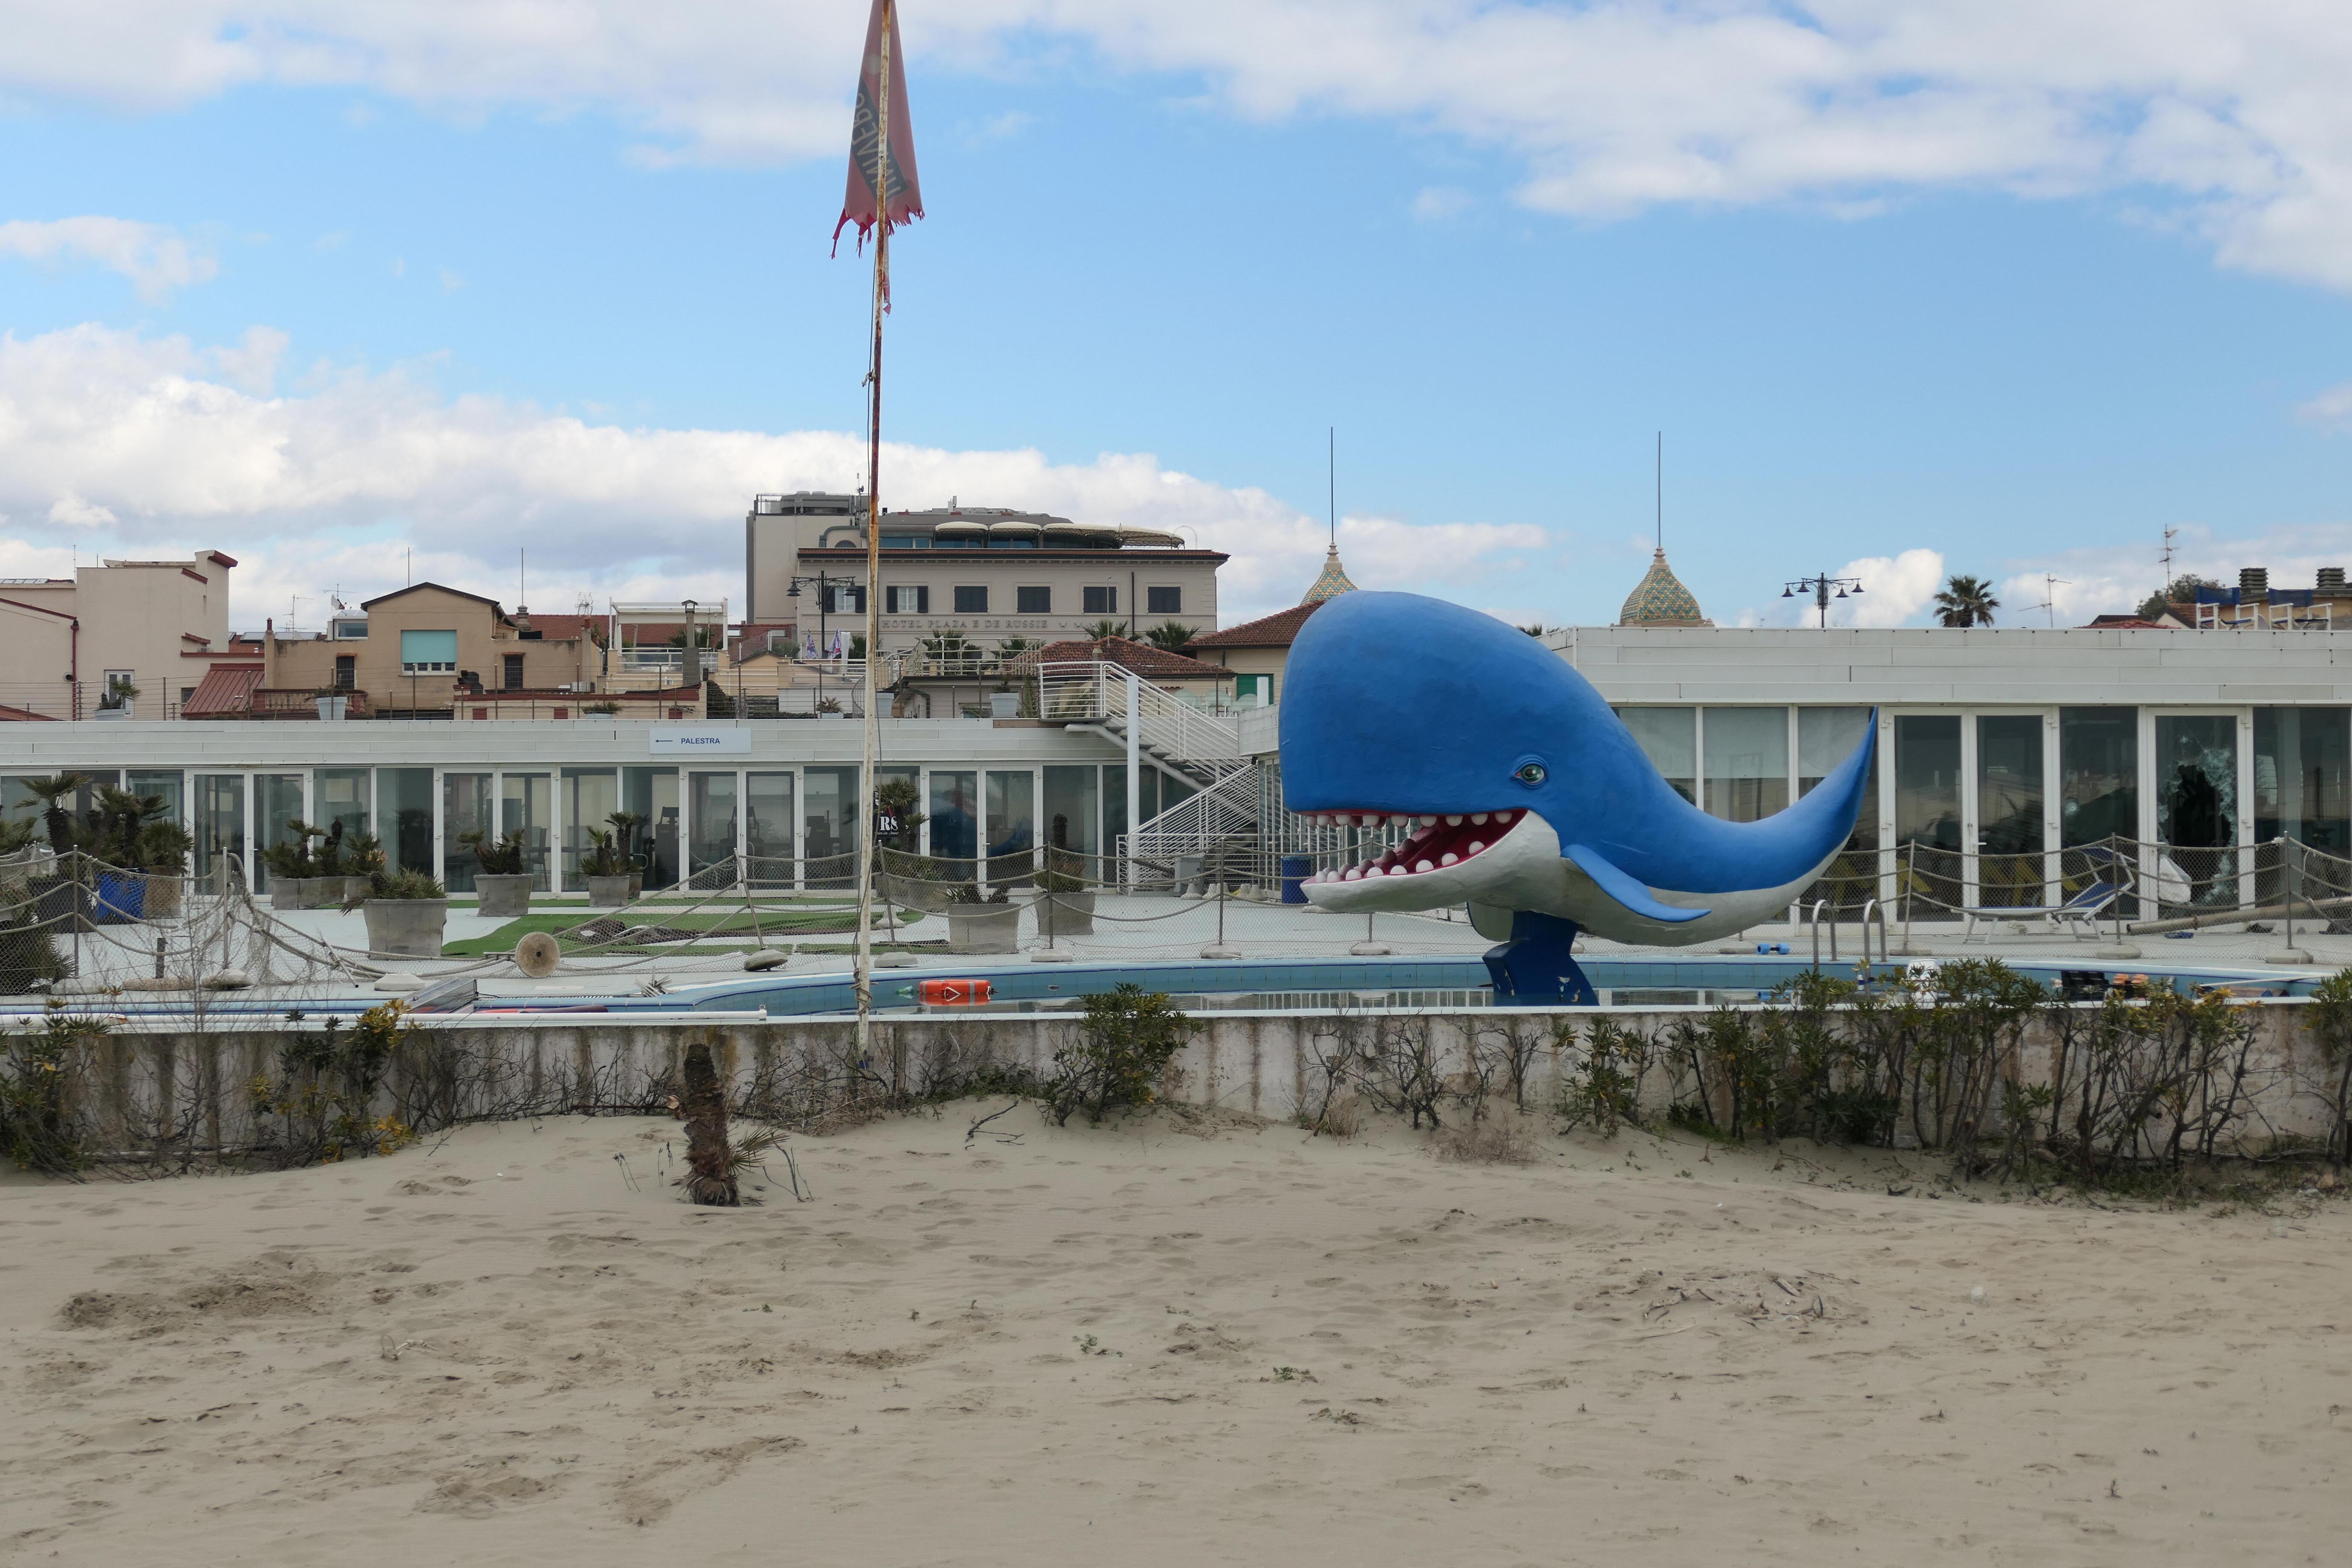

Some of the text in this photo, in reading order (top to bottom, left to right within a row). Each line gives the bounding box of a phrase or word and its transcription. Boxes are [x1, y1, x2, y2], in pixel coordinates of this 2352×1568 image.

[882, 620, 1048, 628] HOTEL PLAZA E DE RUSSIE
